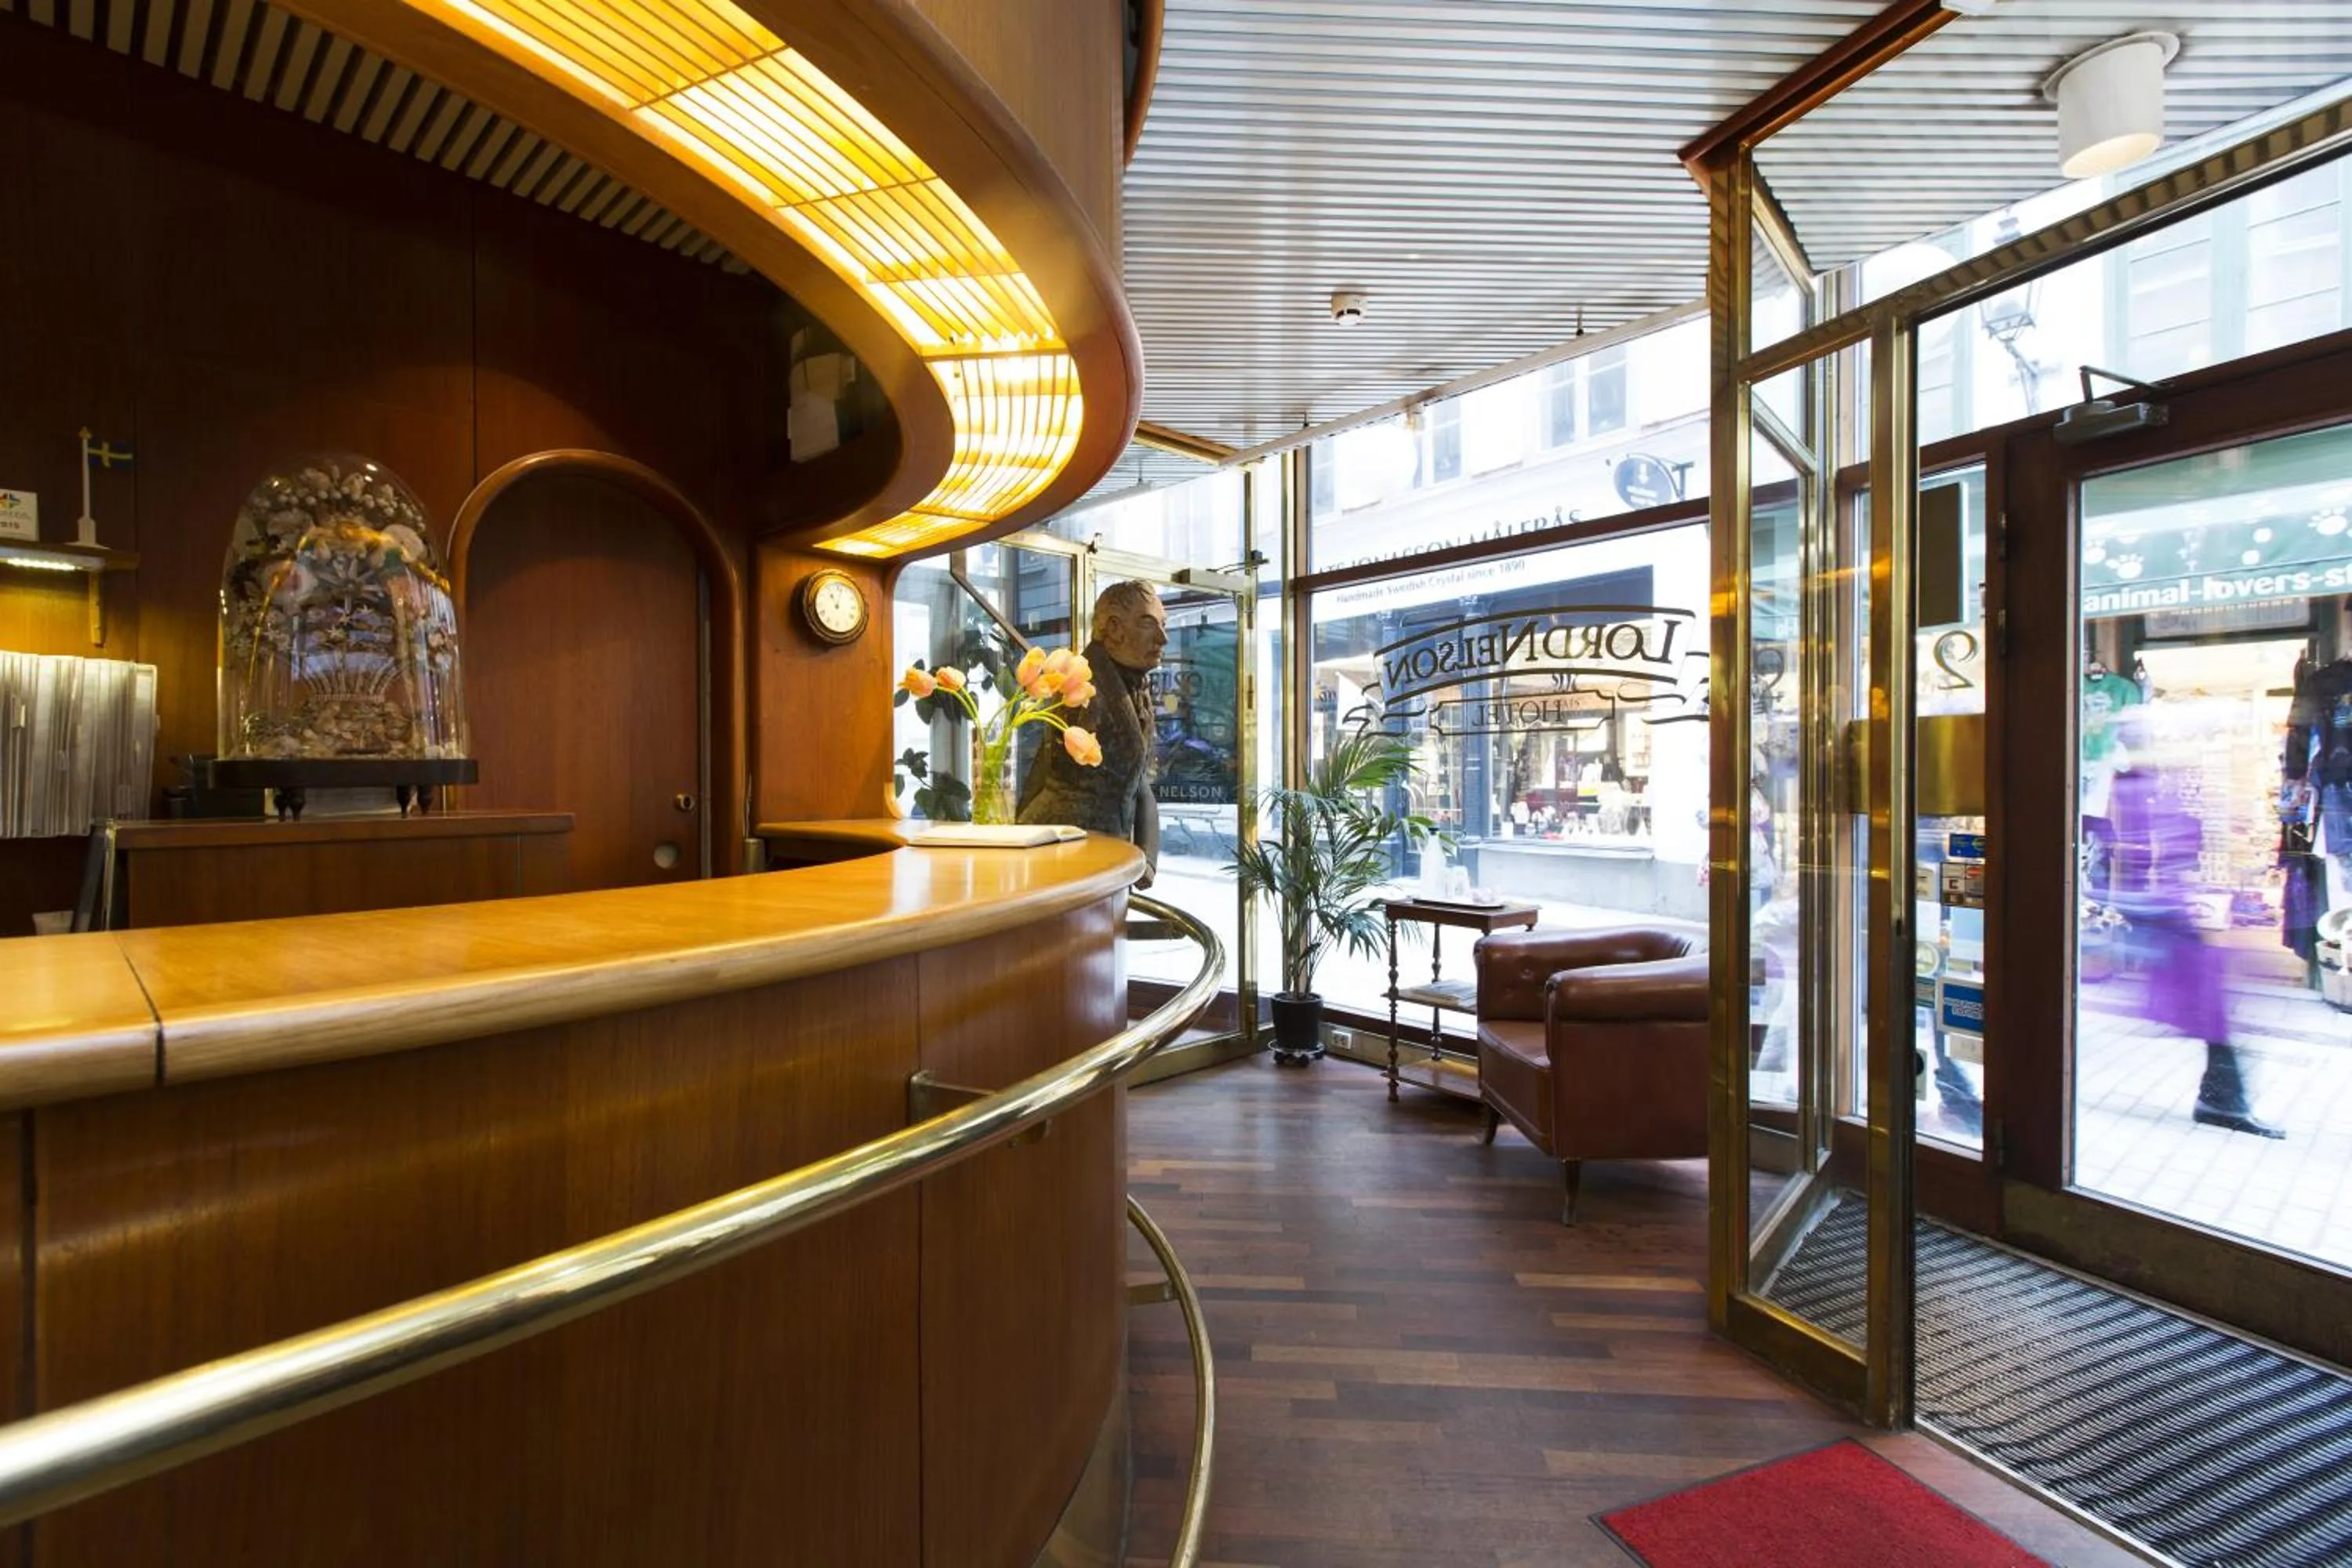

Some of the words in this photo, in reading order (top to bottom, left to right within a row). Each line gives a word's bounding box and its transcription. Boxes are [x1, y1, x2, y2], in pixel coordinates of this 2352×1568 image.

[1428, 569, 1464, 588] Crystal
[1467, 566, 1495, 579] since
[1160, 786, 1222, 798] NELSON
